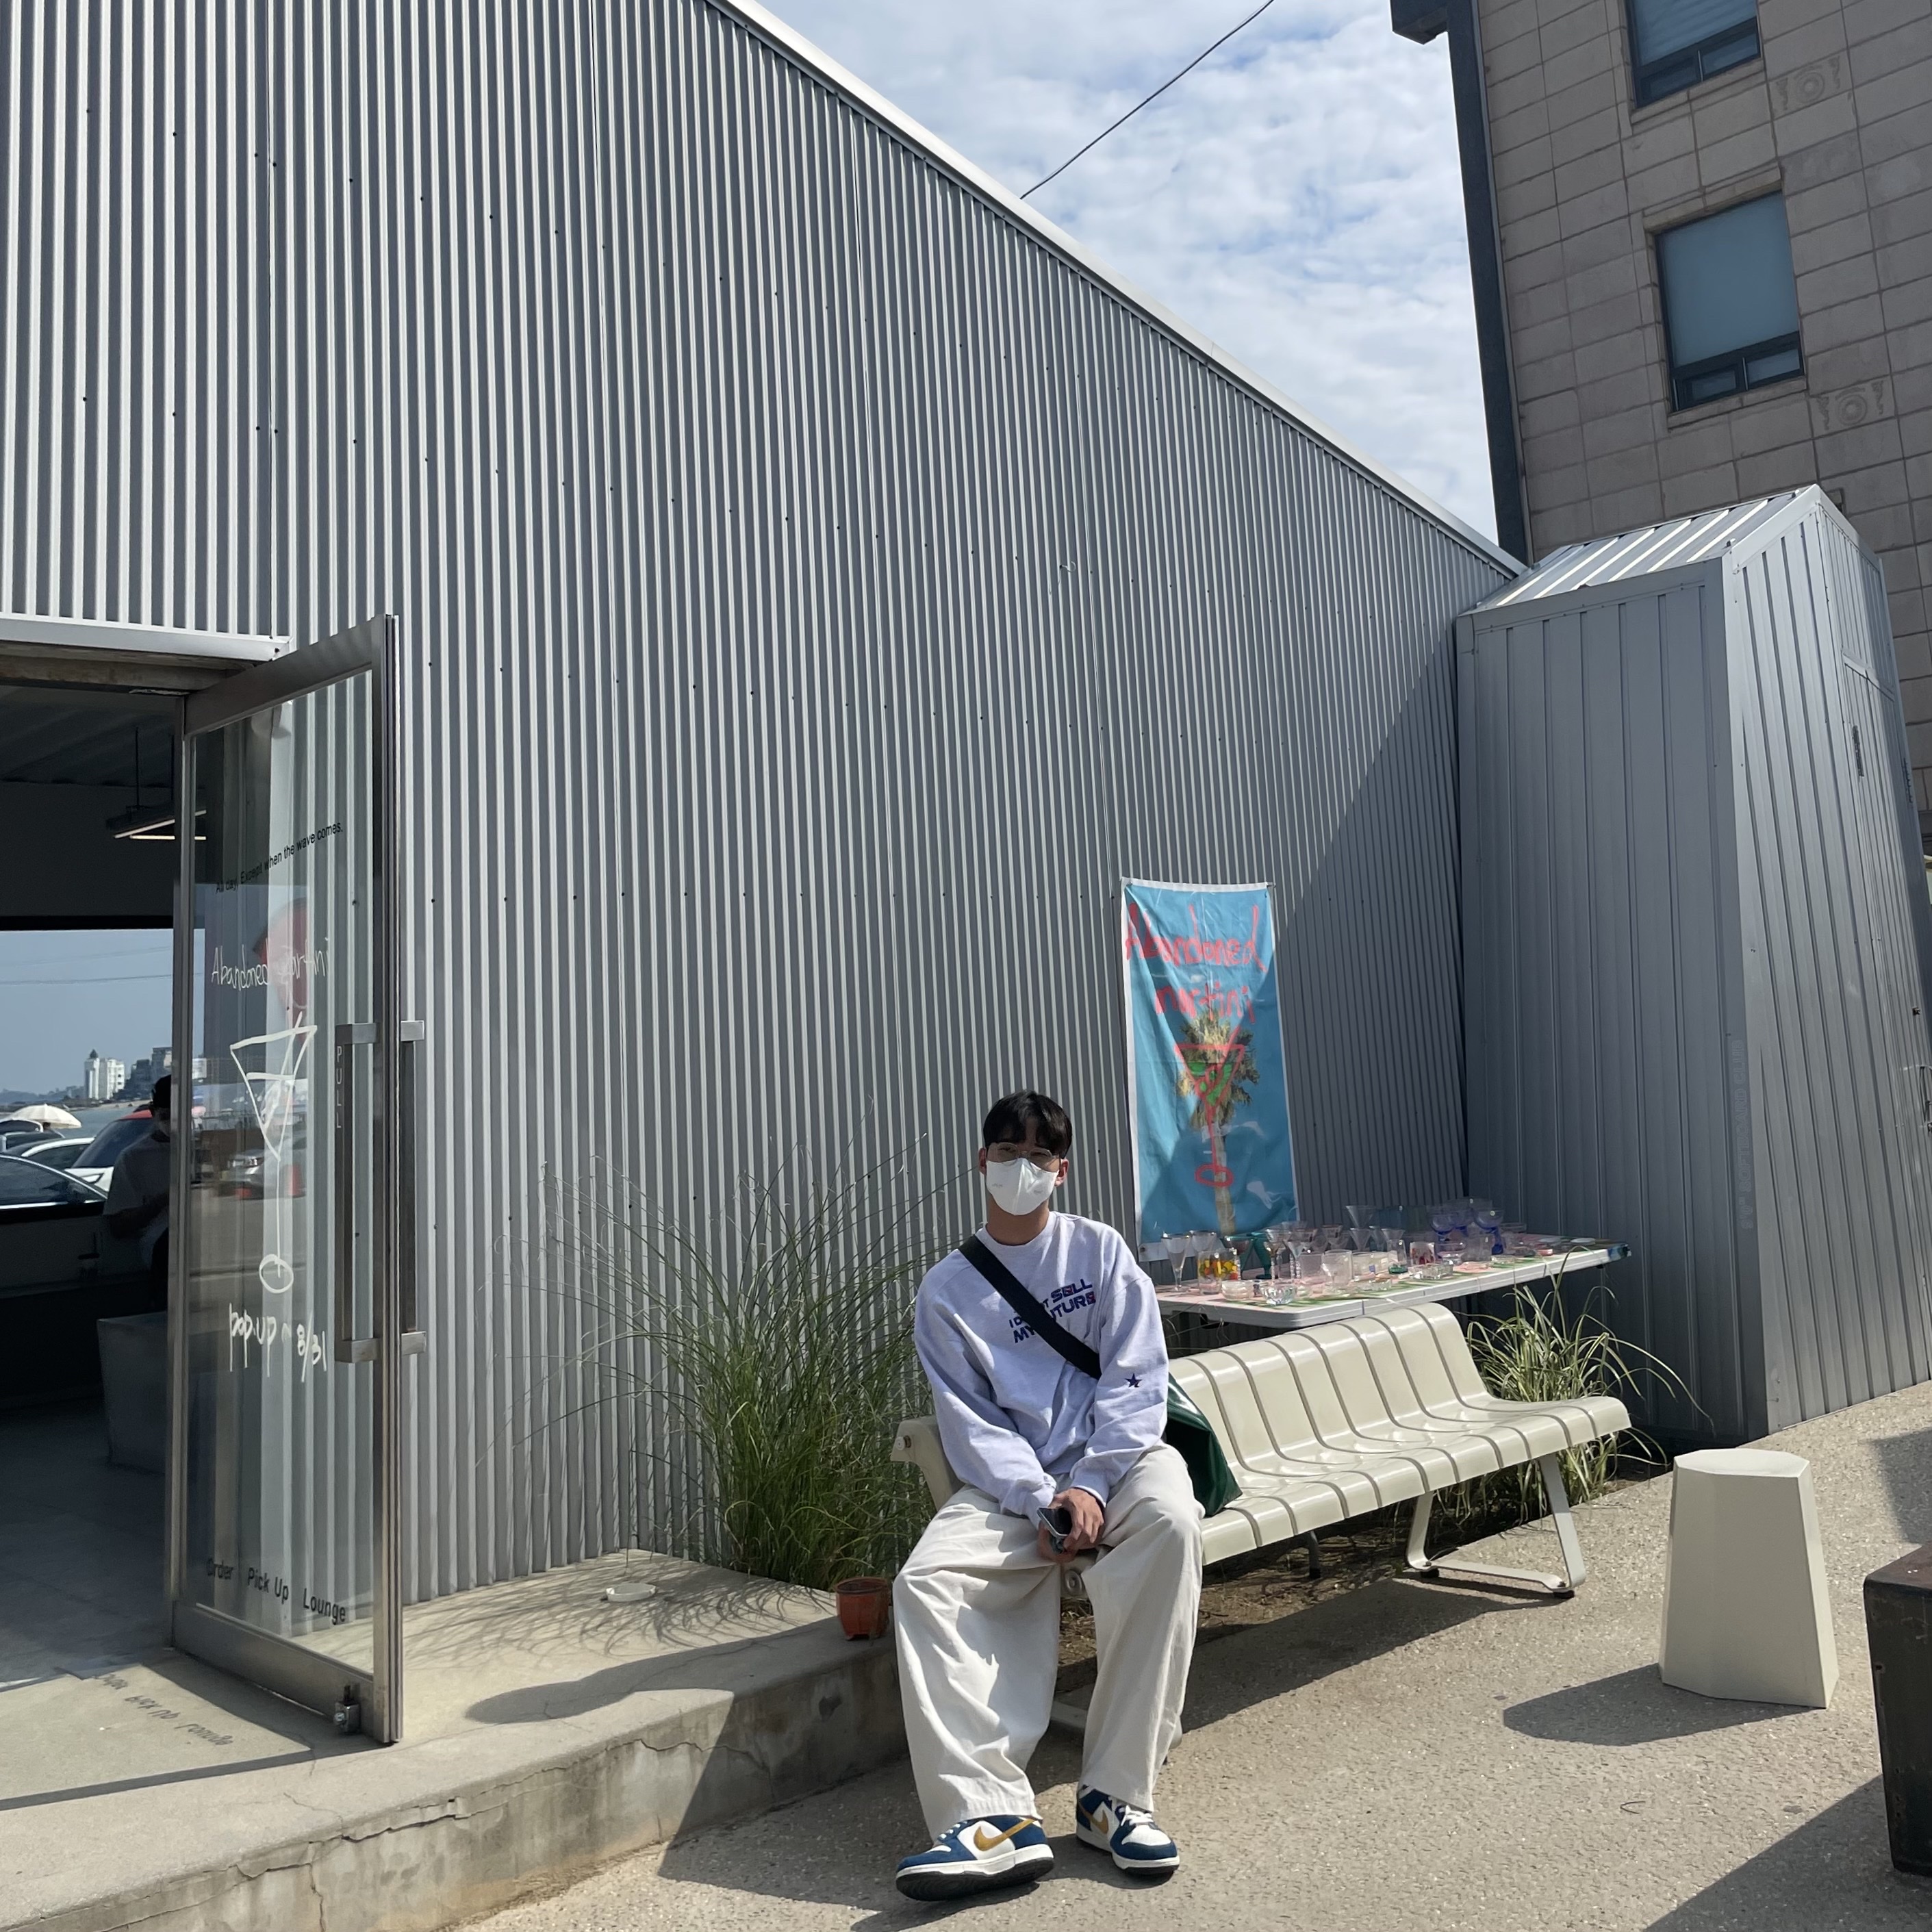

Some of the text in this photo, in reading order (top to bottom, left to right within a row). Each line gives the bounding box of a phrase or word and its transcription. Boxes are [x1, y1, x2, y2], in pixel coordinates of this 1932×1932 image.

[264, 852, 282, 870] when
[283, 845, 294, 859] the
[296, 833, 315, 851] wave
[317, 822, 343, 840] comes.
[247, 1567, 270, 1593] Pick
[274, 1577, 289, 1604] Up
[303, 1588, 346, 1626] Lounge
